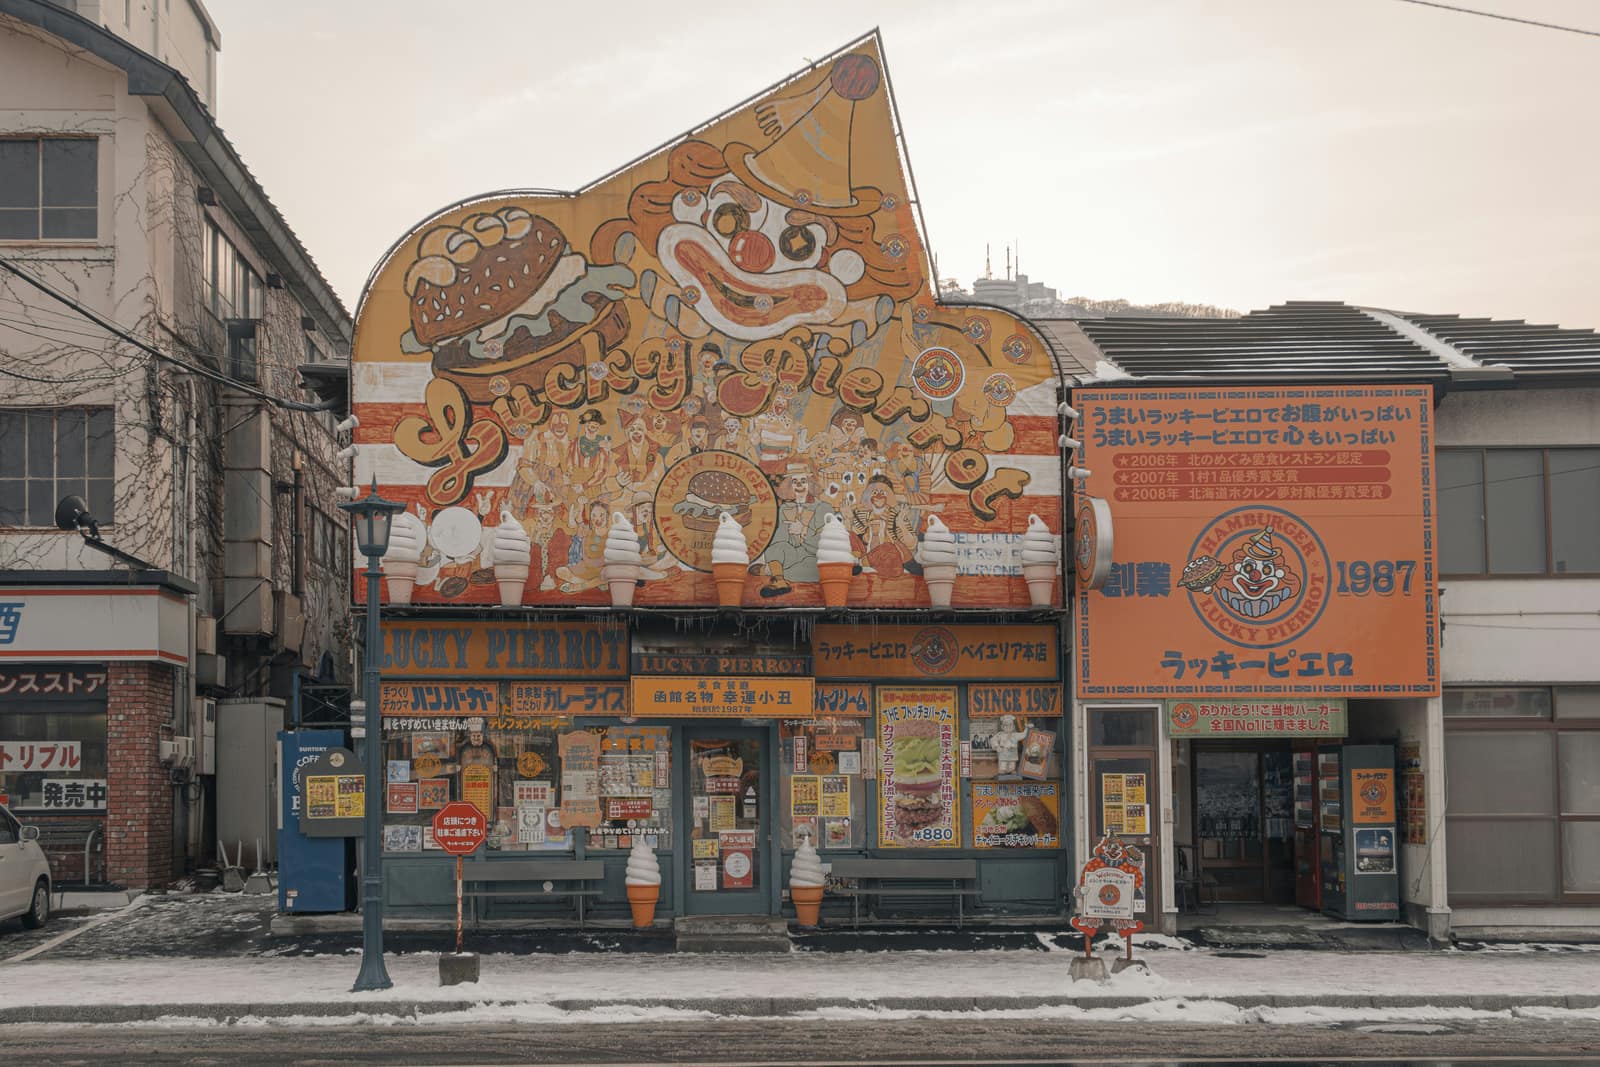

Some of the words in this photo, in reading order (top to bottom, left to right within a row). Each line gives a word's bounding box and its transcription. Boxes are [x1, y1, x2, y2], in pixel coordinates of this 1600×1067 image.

[393, 330, 693, 506] Lucky
[718, 327, 1031, 521] Pierrot
[1091, 404, 1412, 425] うまいラッキーピエロでお腹がいっぱい
[1131, 454, 1179, 467] 2006年
[1188, 452, 1363, 467] 北のめぐみ愛食レストラン認定
[1131, 471, 1179, 484] 2007年
[1189, 469, 1299, 484] 1村1品優秀賞受賞
[1132, 488, 1180, 500] 2008年
[1200, 512, 1317, 557] HAMBURGER
[1336, 560, 1417, 598] 1987
[1199, 598, 1258, 641] LUCKY
[1267, 574, 1323, 641] PIERROT
[485, 628, 625, 670] PIERROT
[818, 641, 906, 661] ラッキーピエロ
[960, 641, 1048, 662] ベイエリア本店
[641, 656, 709, 673] LUCKY
[718, 656, 806, 674] PIERROT
[1160, 649, 1354, 680] ラッキーピエロ
[543, 686, 625, 711] カレーライス
[654, 690, 714, 704] 函館名物
[722, 690, 793, 705] 幸運小丑
[973, 688, 1022, 713] SINCE
[1026, 688, 1058, 712] 1987
[0, 745, 80, 769] トリプル
[44, 783, 106, 808] 発売中
[914, 829, 953, 840] ¥880
